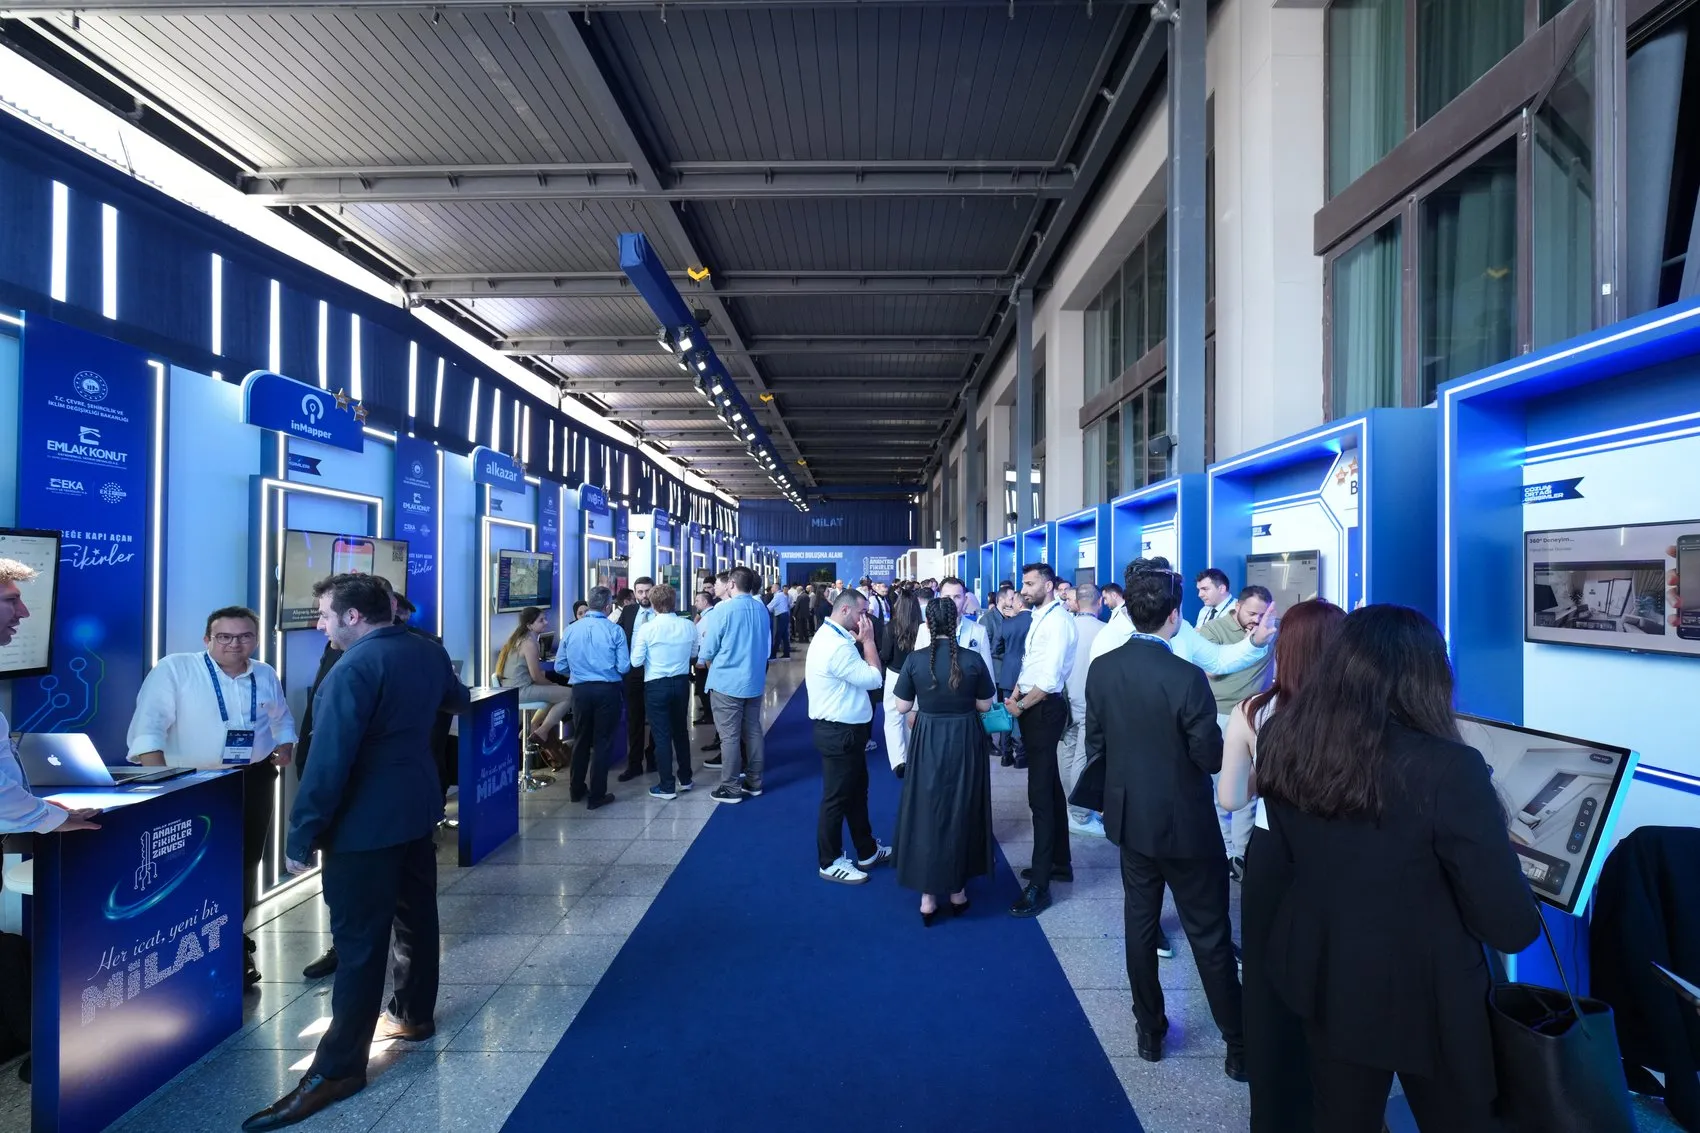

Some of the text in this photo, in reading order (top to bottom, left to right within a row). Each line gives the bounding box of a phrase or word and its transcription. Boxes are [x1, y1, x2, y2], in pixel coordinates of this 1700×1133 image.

[291, 419, 333, 439] inMapper
[46, 439, 88, 456] EMLAK
[89, 447, 128, 462] KONUT
[486, 461, 518, 482] alkazar
[85, 531, 107, 541] KAPI
[109, 533, 133, 543] AÇAN
[476, 764, 516, 804] MİLAT
[152, 819, 192, 841] ANAHTAR
[152, 828, 192, 850] FİKİRLER
[152, 839, 186, 859] ZİRVESİ
[87, 899, 219, 981] Her icat, yeni bir
[81, 913, 229, 1027] MİLAT
